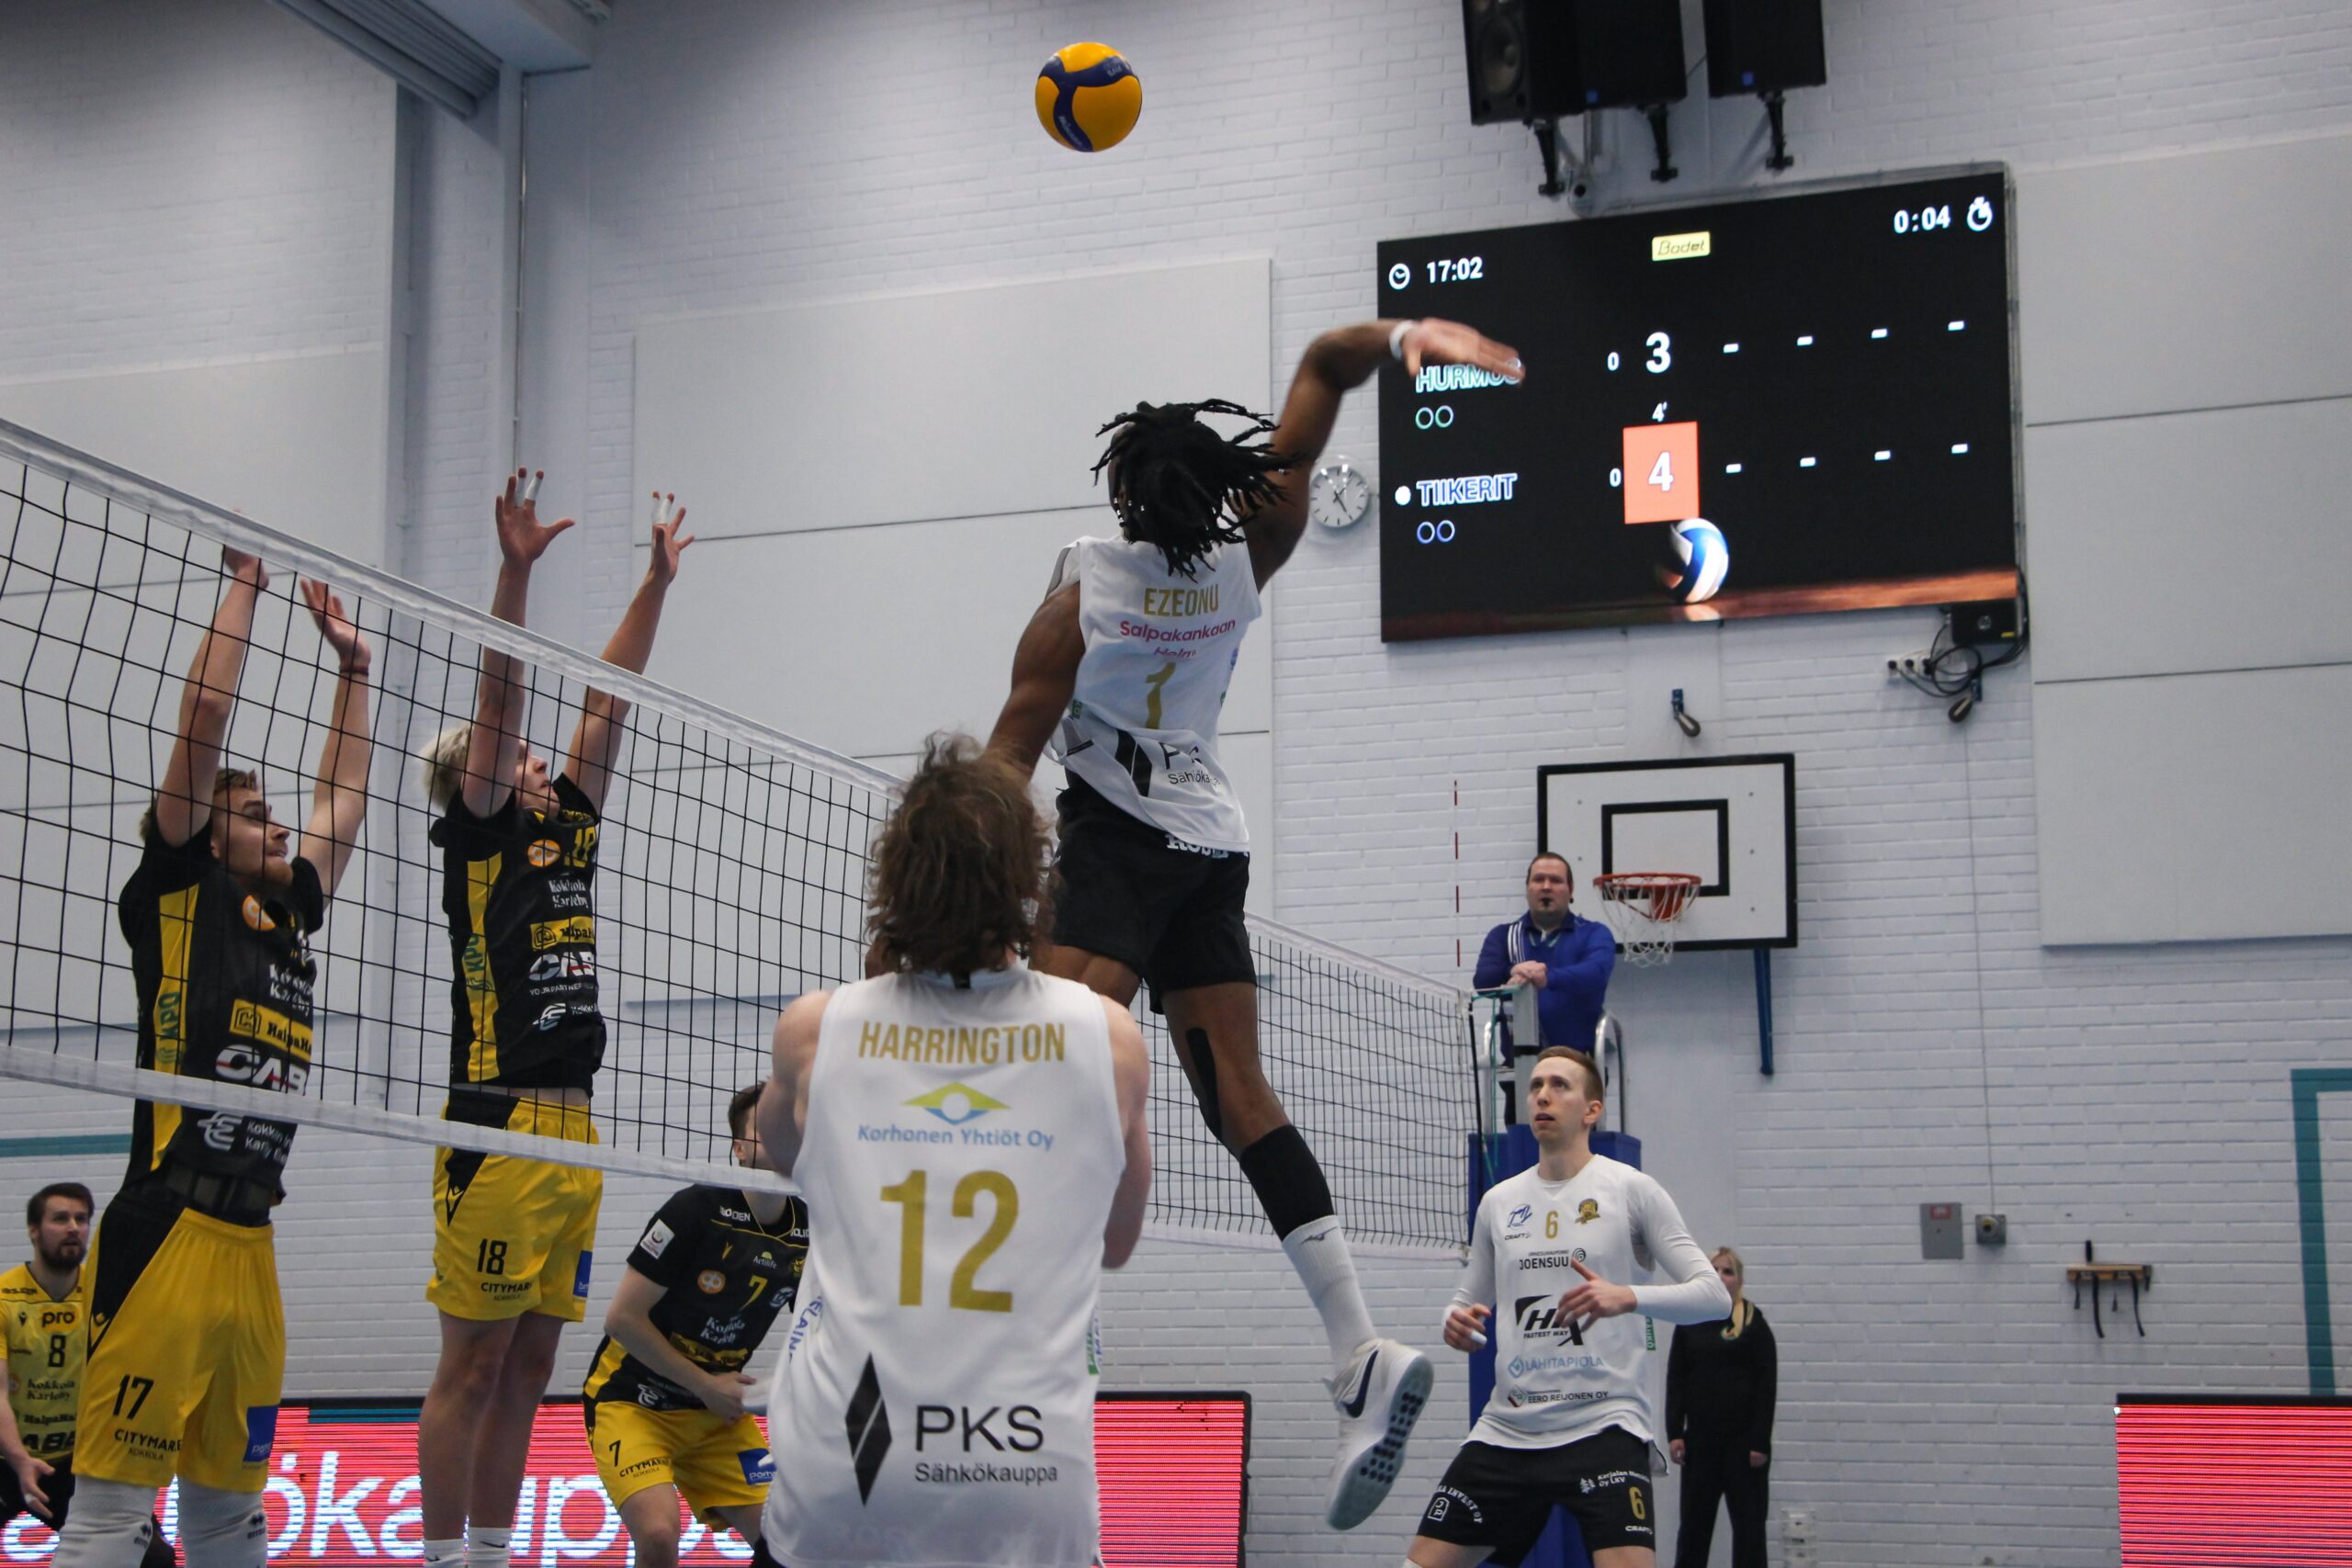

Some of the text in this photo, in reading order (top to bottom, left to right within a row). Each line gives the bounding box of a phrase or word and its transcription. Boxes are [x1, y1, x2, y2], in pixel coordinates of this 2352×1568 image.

[1894, 205, 1951, 233] 0:04
[1427, 256, 1483, 283] 17:02
[1608, 332, 1671, 373] 0 3
[1610, 451, 1674, 491] 0 4
[1417, 473, 1518, 506] TIIKERIT
[1144, 584, 1219, 617] EZEONU
[1120, 620, 1236, 642] Salpakankaan
[1146, 662, 1176, 729] 1
[859, 1021, 1065, 1064] HARRINGTON
[857, 1123, 1056, 1151] Korhonen Yhtiöt Oy
[1545, 1211, 1559, 1239] 6
[478, 1238, 507, 1275] 18
[880, 1169, 1020, 1314] 12
[1519, 1256, 1569, 1270] JOENSUU
[740, 1275, 768, 1311] 7
[42, 1311, 74, 1327] pro
[48, 1335, 65, 1367] 8
[113, 1374, 154, 1420] 17
[1528, 1394, 1548, 1404] EERO
[1595, 1391, 1609, 1399] OY
[916, 1404, 1044, 1452] PKS
[609, 1440, 621, 1467] 7
[914, 1462, 1058, 1485] Sähkökauppa
[1447, 1487, 1477, 1510] INVEST
[1629, 1487, 1646, 1520] 6
